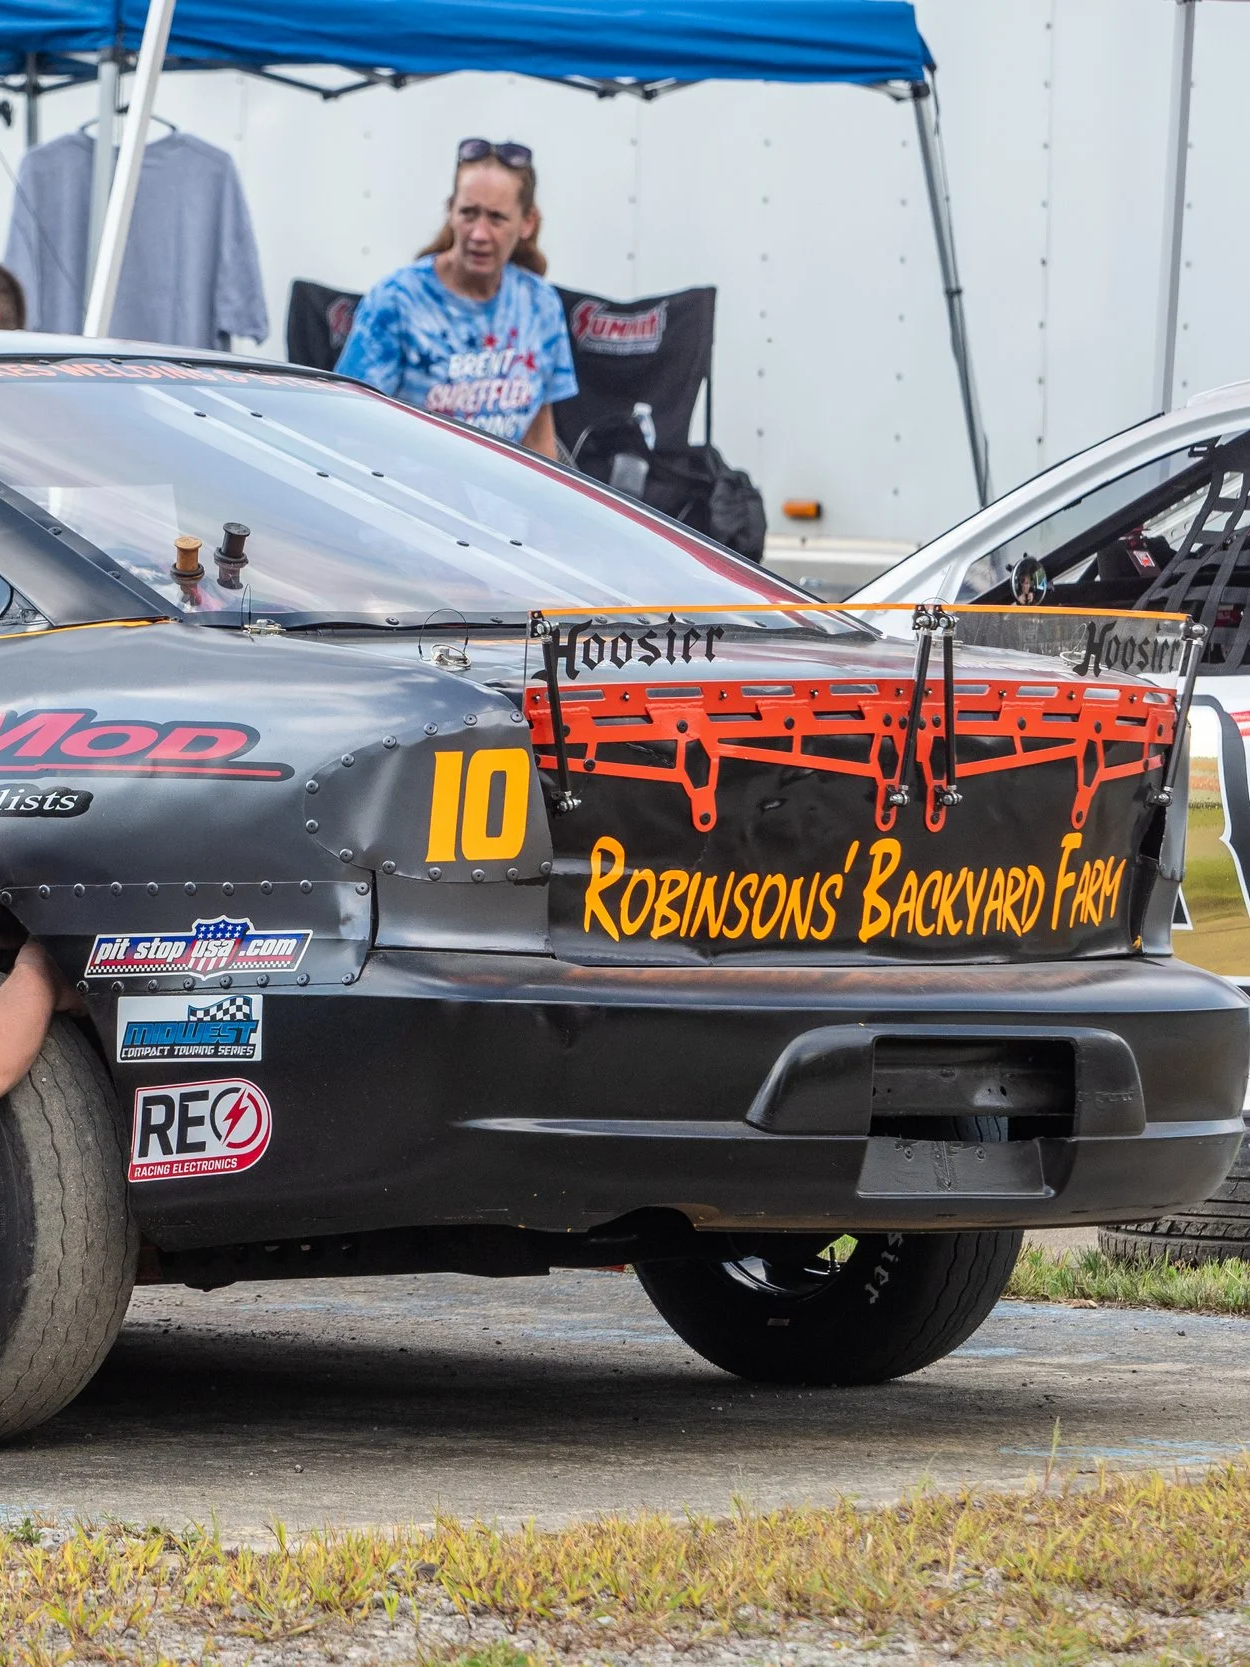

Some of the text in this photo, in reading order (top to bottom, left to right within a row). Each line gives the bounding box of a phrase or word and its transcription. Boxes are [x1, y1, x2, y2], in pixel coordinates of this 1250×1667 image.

[54, 363, 218, 381] WELDING
[449, 349, 516, 378] BRENT
[462, 414, 519, 438] ACING
[531, 612, 726, 681] Hoosier
[1072, 620, 1181, 678] Hoosier
[425, 748, 530, 862] 10
[584, 832, 1127, 944] ROBINSONS' BACKYARD FARM
[95, 938, 131, 965] pit
[133, 938, 187, 962] stop
[191, 939, 236, 958] usa
[124, 1021, 257, 1046] MIDWEST
[122, 1046, 255, 1059] COMPACT TOURING SERIES
[134, 1158, 238, 1177] RACING ELECTRONICS
